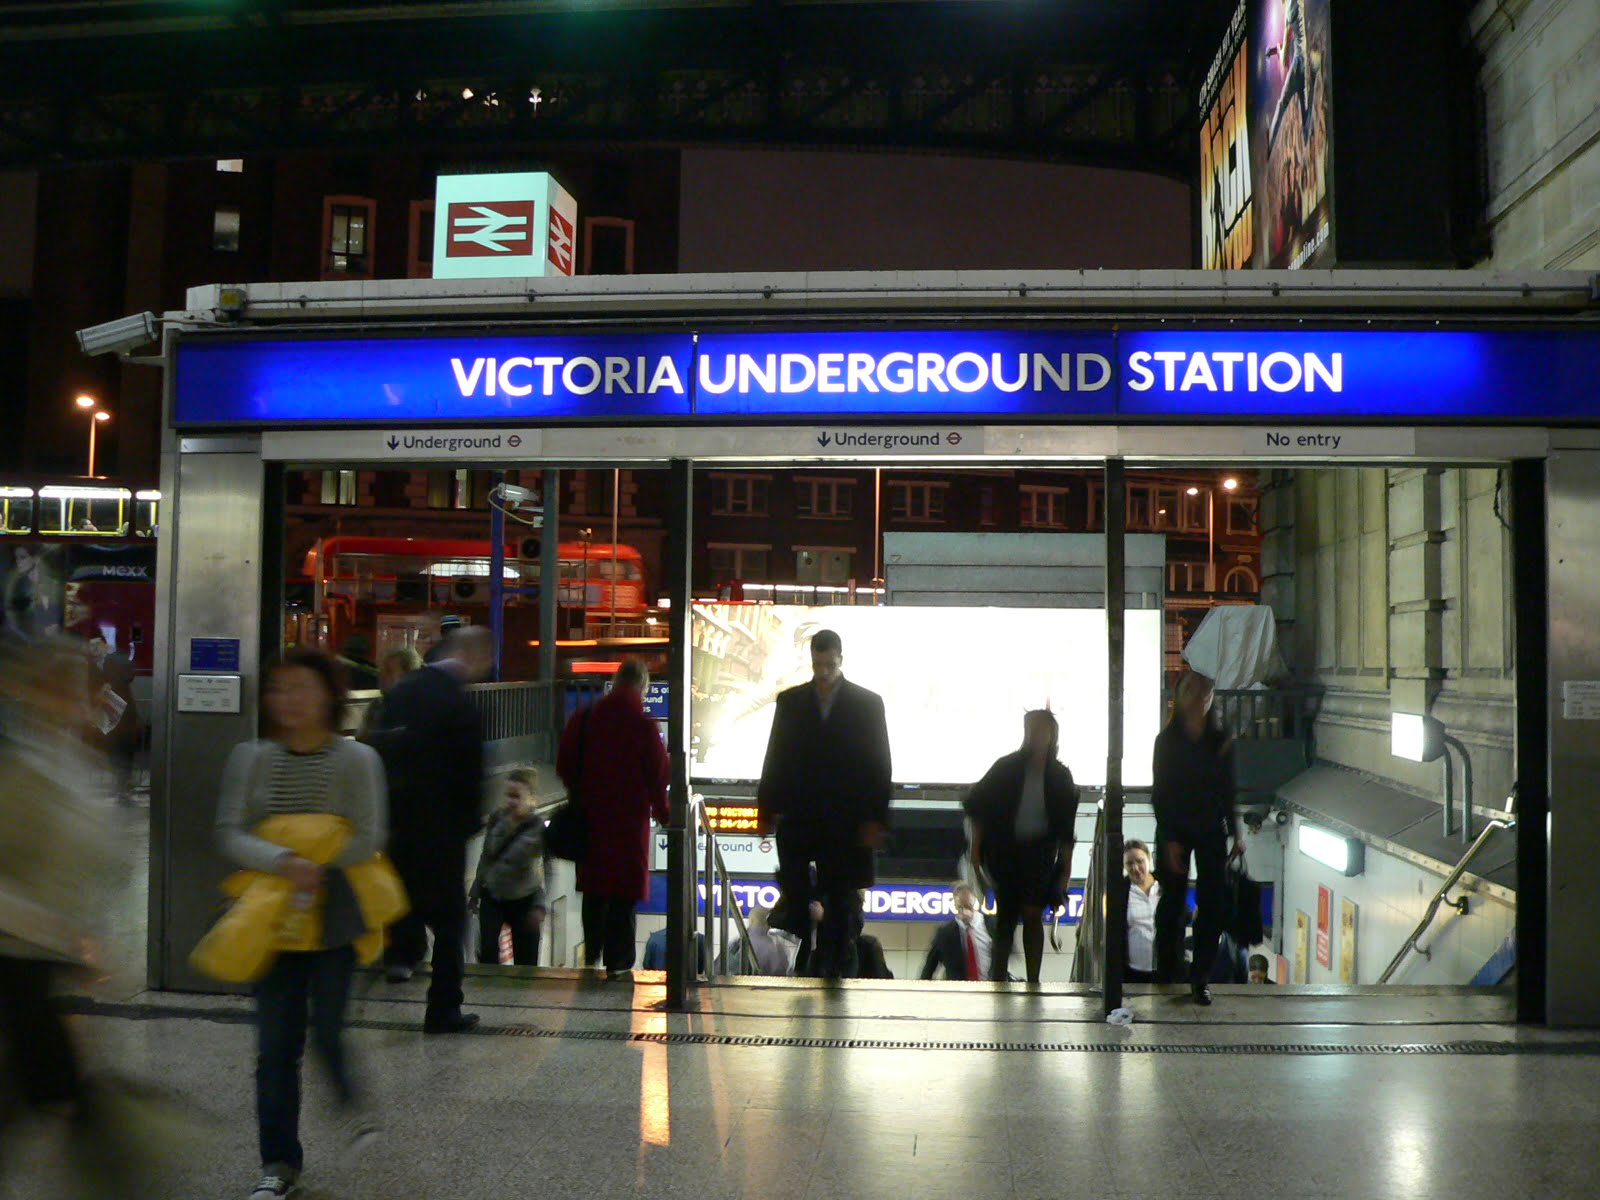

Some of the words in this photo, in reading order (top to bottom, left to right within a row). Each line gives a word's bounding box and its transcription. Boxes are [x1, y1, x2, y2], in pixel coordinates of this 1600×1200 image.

[450, 355, 685, 396] VICTORIA
[699, 351, 1112, 394] UNDERGROUND
[1127, 350, 1344, 393] STATION
[403, 434, 502, 452] Underground
[834, 431, 940, 449] Underground
[1266, 432, 1290, 447] No
[1296, 432, 1342, 450] entry
